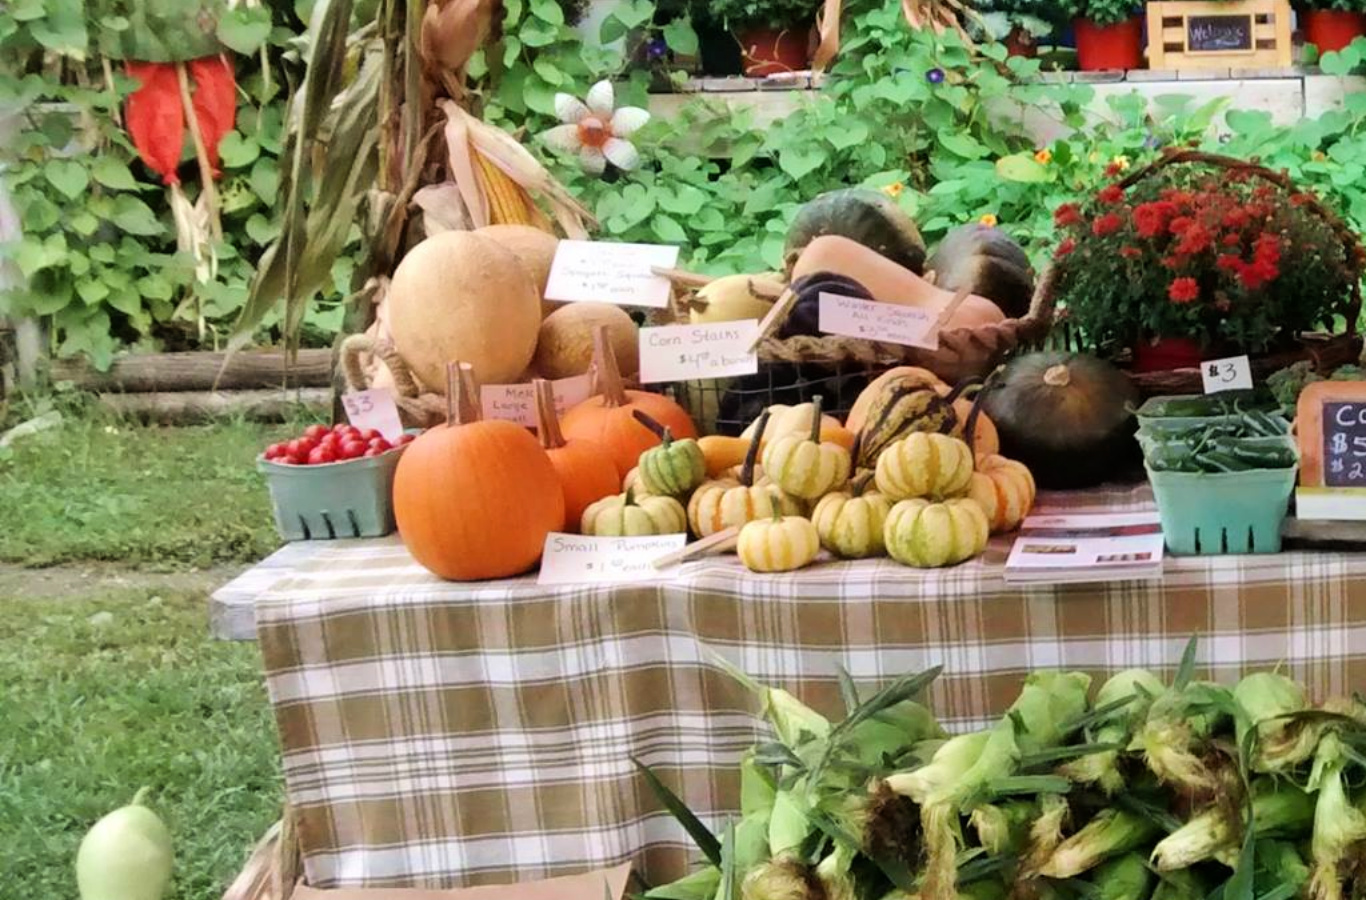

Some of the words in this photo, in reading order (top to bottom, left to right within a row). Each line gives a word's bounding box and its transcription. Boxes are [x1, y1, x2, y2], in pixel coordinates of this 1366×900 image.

[649, 332, 682, 347] Corn
[1208, 363, 1237, 383] $3
[346, 395, 374, 416] $3
[554, 538, 599, 553] Small
